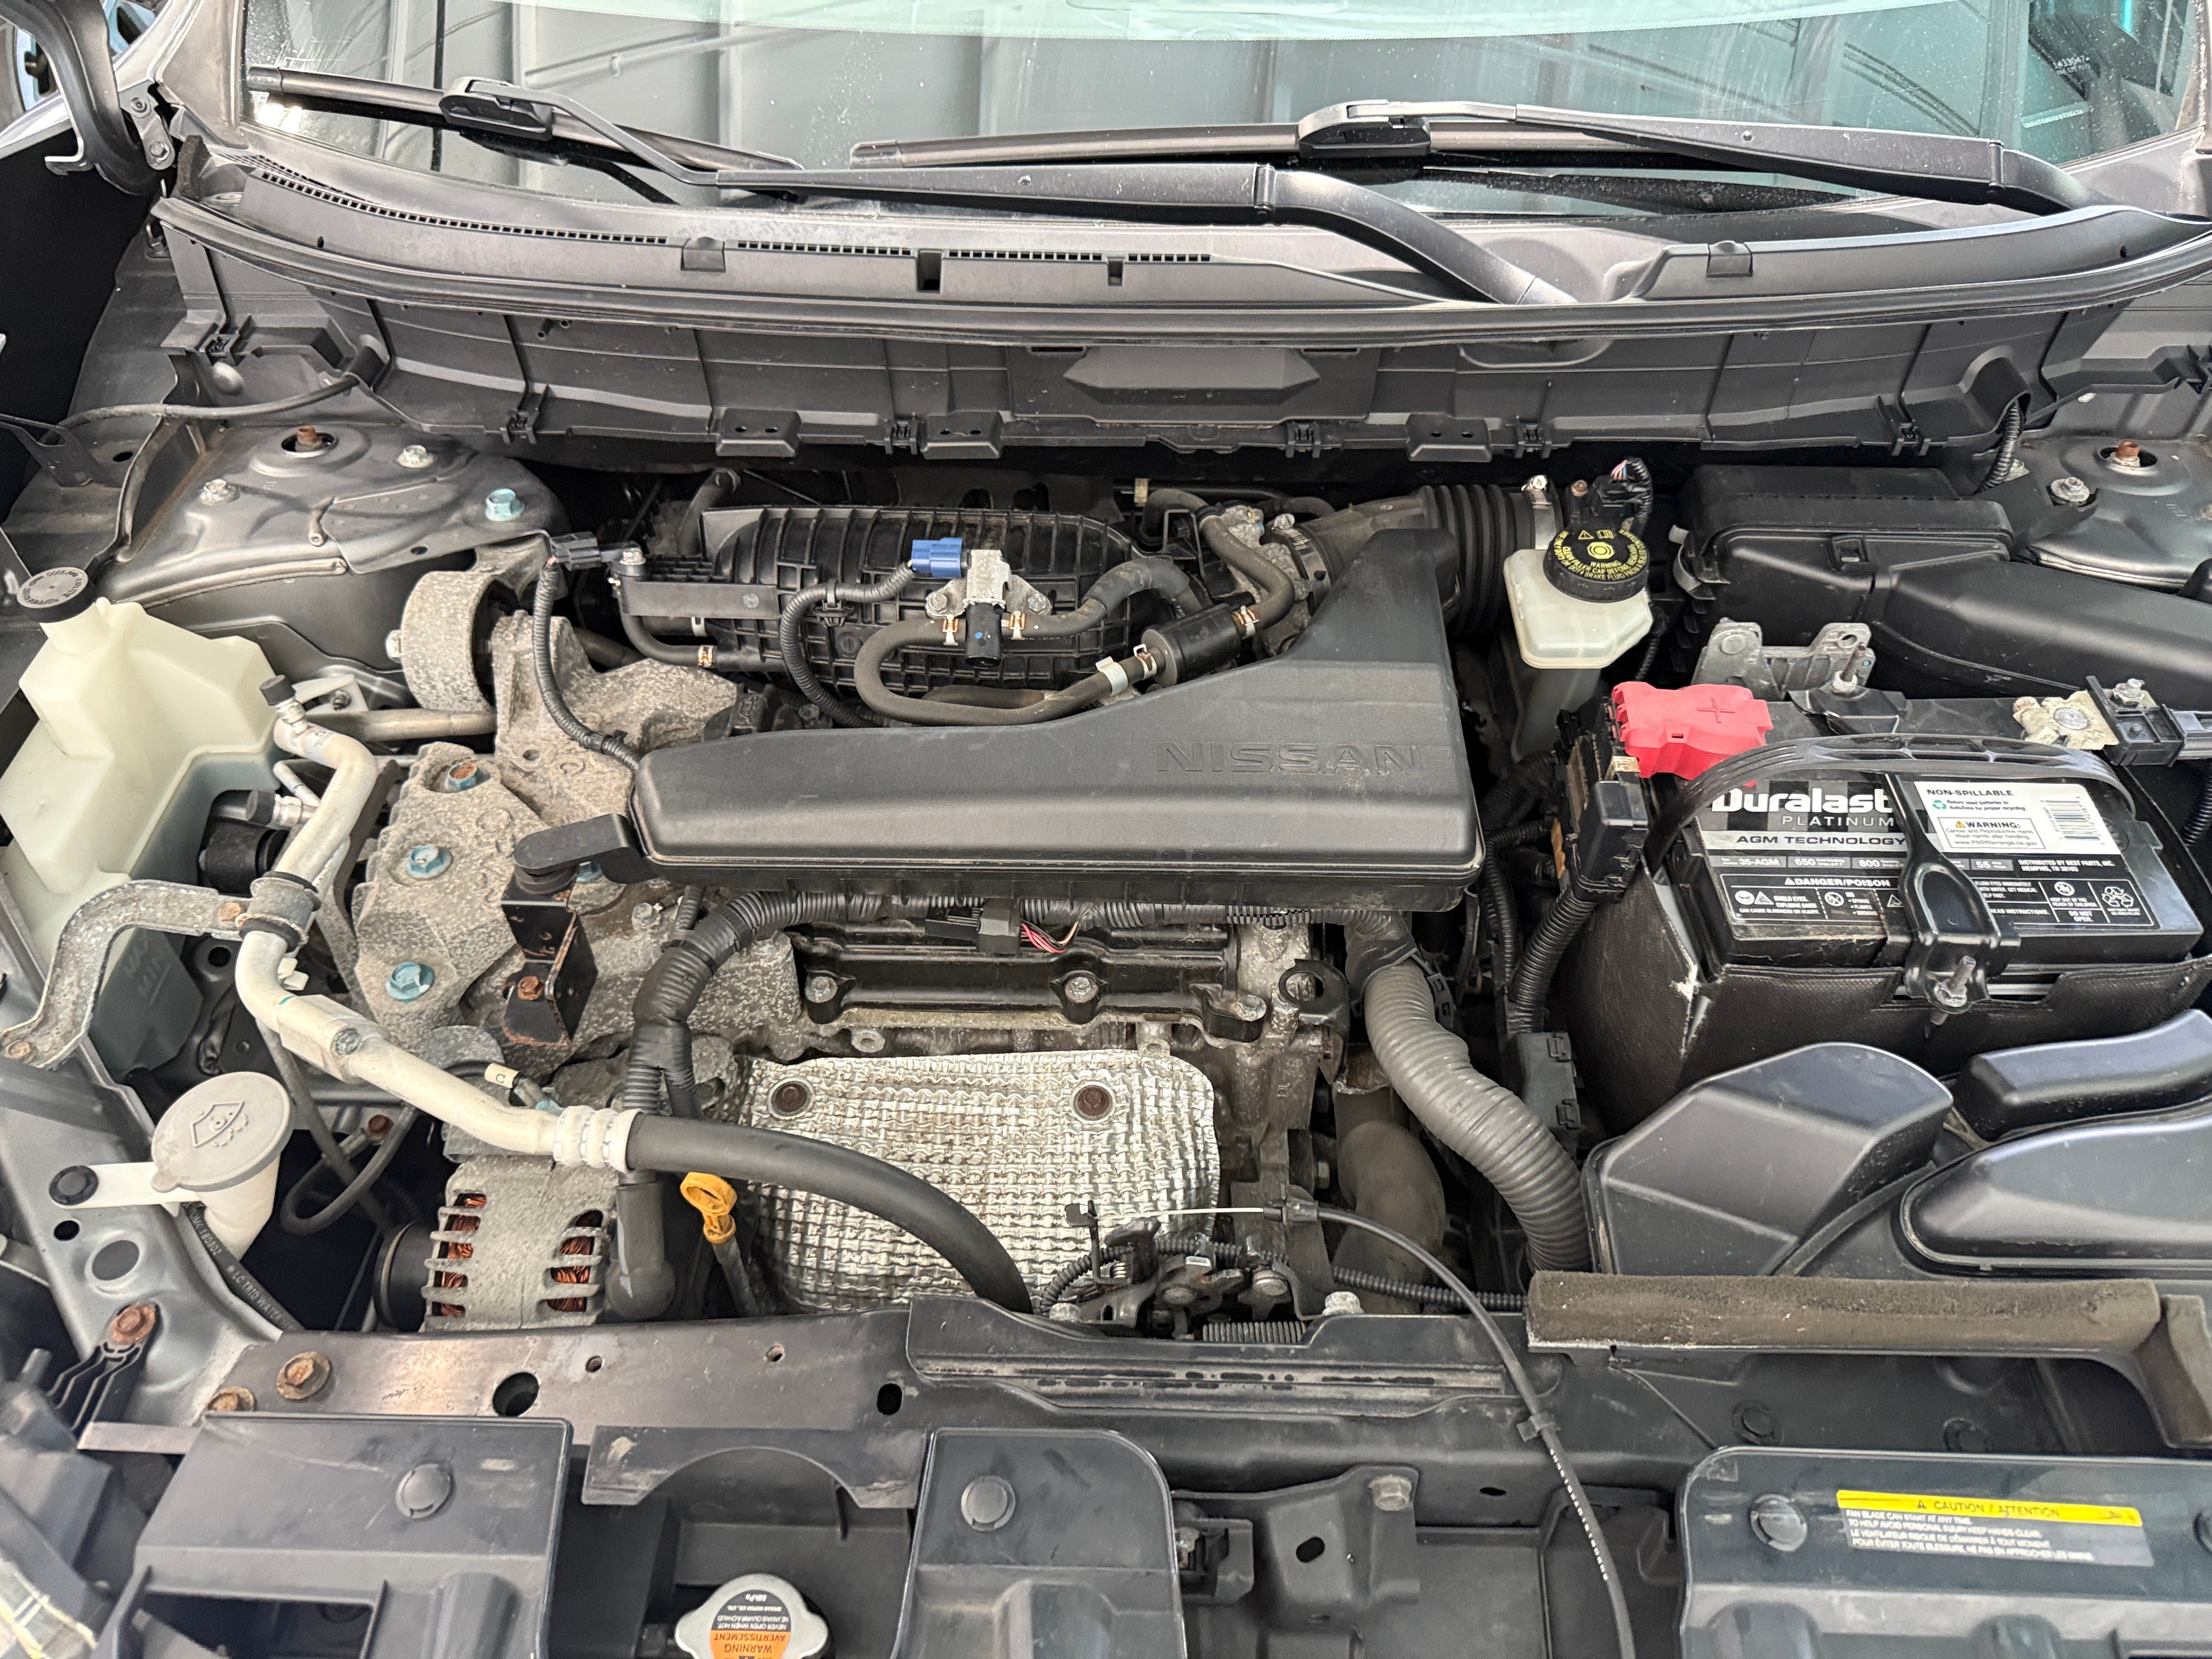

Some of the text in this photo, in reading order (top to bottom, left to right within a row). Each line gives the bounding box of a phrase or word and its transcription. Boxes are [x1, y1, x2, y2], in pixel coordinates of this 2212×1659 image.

[1562, 546, 1576, 561] CLEAN
[1571, 559, 1592, 572] FILLER
[1606, 563, 1632, 575] BEFORE
[1590, 561, 1621, 569] WARNING
[1567, 564, 1585, 575] DOT4
[1584, 572, 1606, 580] BRAKE
[1623, 566, 1641, 577] FROM
[1158, 742, 1424, 775] NISSAN
[1711, 788, 1893, 814] Duralast
[1782, 816, 1894, 827] PLATINUM
[1736, 836, 1906, 845] AGM TECHNOLOGY
[1794, 877, 1891, 887] DANGER/POISON
[1934, 1499, 1984, 1513] CAUTION
[1997, 1505, 2060, 1517] ATTENTION
[1846, 1509, 1861, 1519] FAN
[1861, 1510, 1886, 1520] BLADE
[1886, 1511, 1903, 1521] CAN
[1903, 1513, 1927, 1522] START
[1927, 1514, 1937, 1522] AT
[1937, 1514, 1954, 1524] ANY
[1848, 1517, 1860, 1527] TO
[1859, 1519, 1880, 1528] HELP
[1880, 1520, 1903, 1530] AVOID
[1902, 1521, 1943, 1532] PERSONAL
[1850, 1528, 1861, 1537] LE
[1860, 1529, 1908, 1539] VENTILATEUR
[1852, 1538, 1874, 1548] POUR
[730, 1622, 750, 1630] WHEN
[749, 1622, 767, 1630] OPEN
[766, 1622, 787, 1630] NEVER
[713, 1632, 787, 1642] AVERTISSEMENT
[724, 1643, 772, 1654] WARNING
